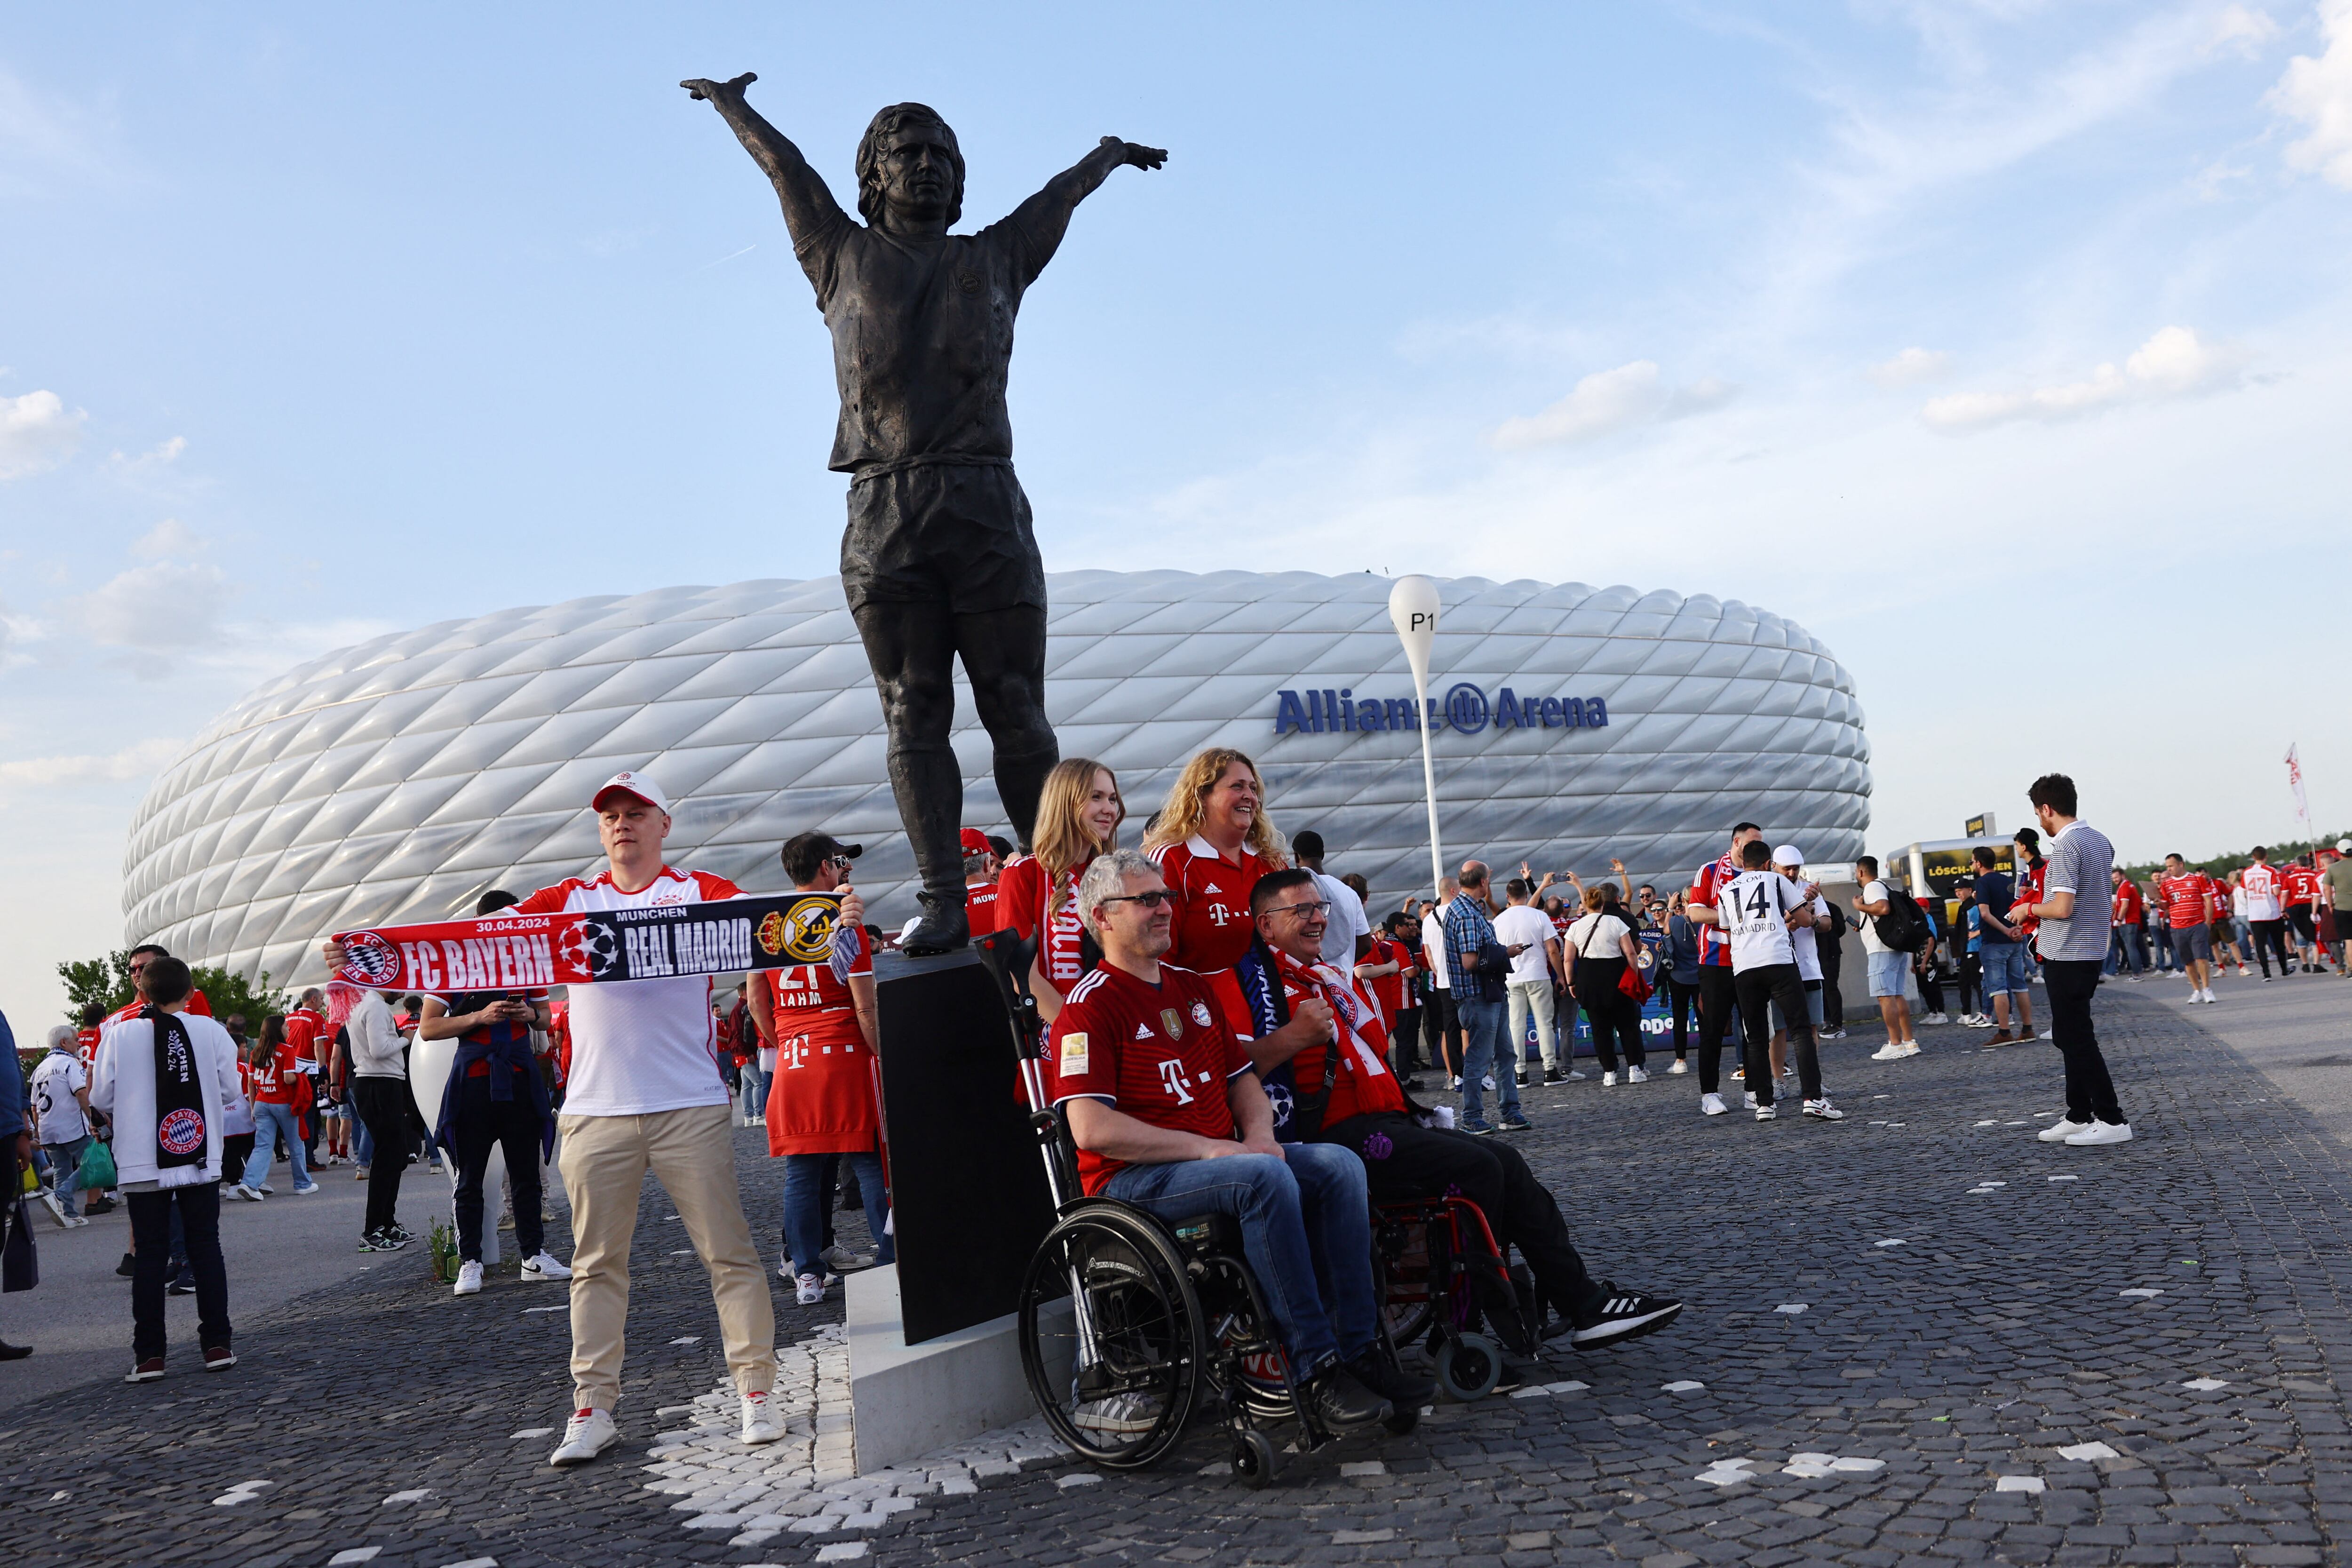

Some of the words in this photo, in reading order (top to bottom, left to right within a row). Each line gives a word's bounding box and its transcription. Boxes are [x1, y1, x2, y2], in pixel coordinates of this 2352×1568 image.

[1411, 613, 1433, 631] P1
[1276, 689, 1440, 733] Allianz
[1497, 688, 1608, 728] Arena
[1929, 862, 2012, 876] LÖSCH-EN
[2248, 877, 2267, 894] 42
[2298, 878, 2308, 894] 5
[973, 893, 998, 906] MÜNC
[1729, 882, 1770, 923] 14
[616, 907, 687, 922] MUNCHEN
[476, 918, 550, 932] 30.04.2024
[364, 935, 379, 946] FC
[625, 925, 673, 978] REAL
[675, 918, 753, 974] MADRID
[371, 946, 396, 983] BAYERN
[400, 941, 441, 989] FC
[440, 934, 554, 988] BAYERN
[780, 992, 822, 1007] LAHM
[1255, 963, 1279, 1035] ADRI
[1136, 1031, 1155, 1040] adidas
[254, 1057, 276, 1084] 42
[37, 1081, 53, 1112] 5
[162, 1121, 171, 1131] FC
[170, 1111, 201, 1126] BAYERN
